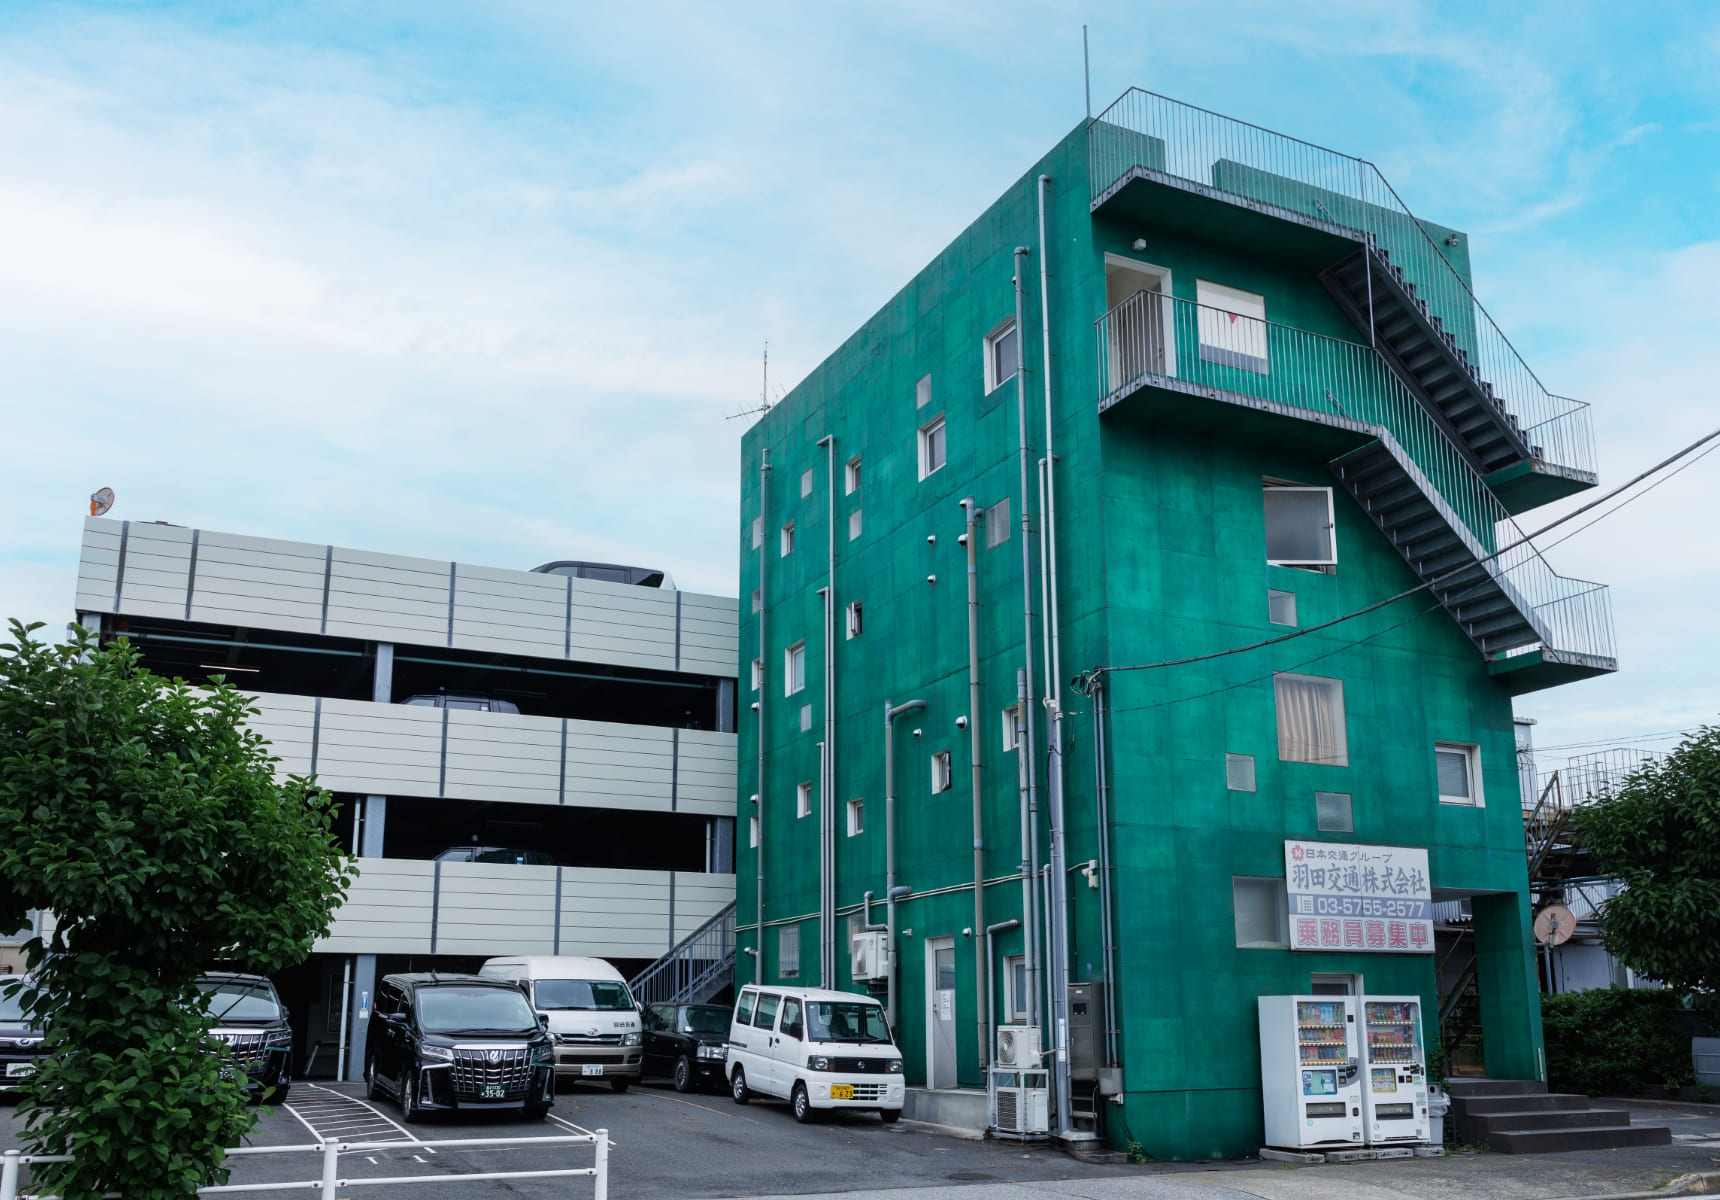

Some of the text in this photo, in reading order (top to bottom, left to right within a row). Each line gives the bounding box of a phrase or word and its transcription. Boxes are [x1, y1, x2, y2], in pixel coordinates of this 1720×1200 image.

[1305, 848, 1392, 864] 日本交通グループ
[1292, 863, 1426, 895] 羽田交通株式会社
[1317, 898, 1425, 917] 03-5755-2577
[1297, 918, 1429, 948] 乗務員募集中
[485, 1090, 505, 1098] 35-02
